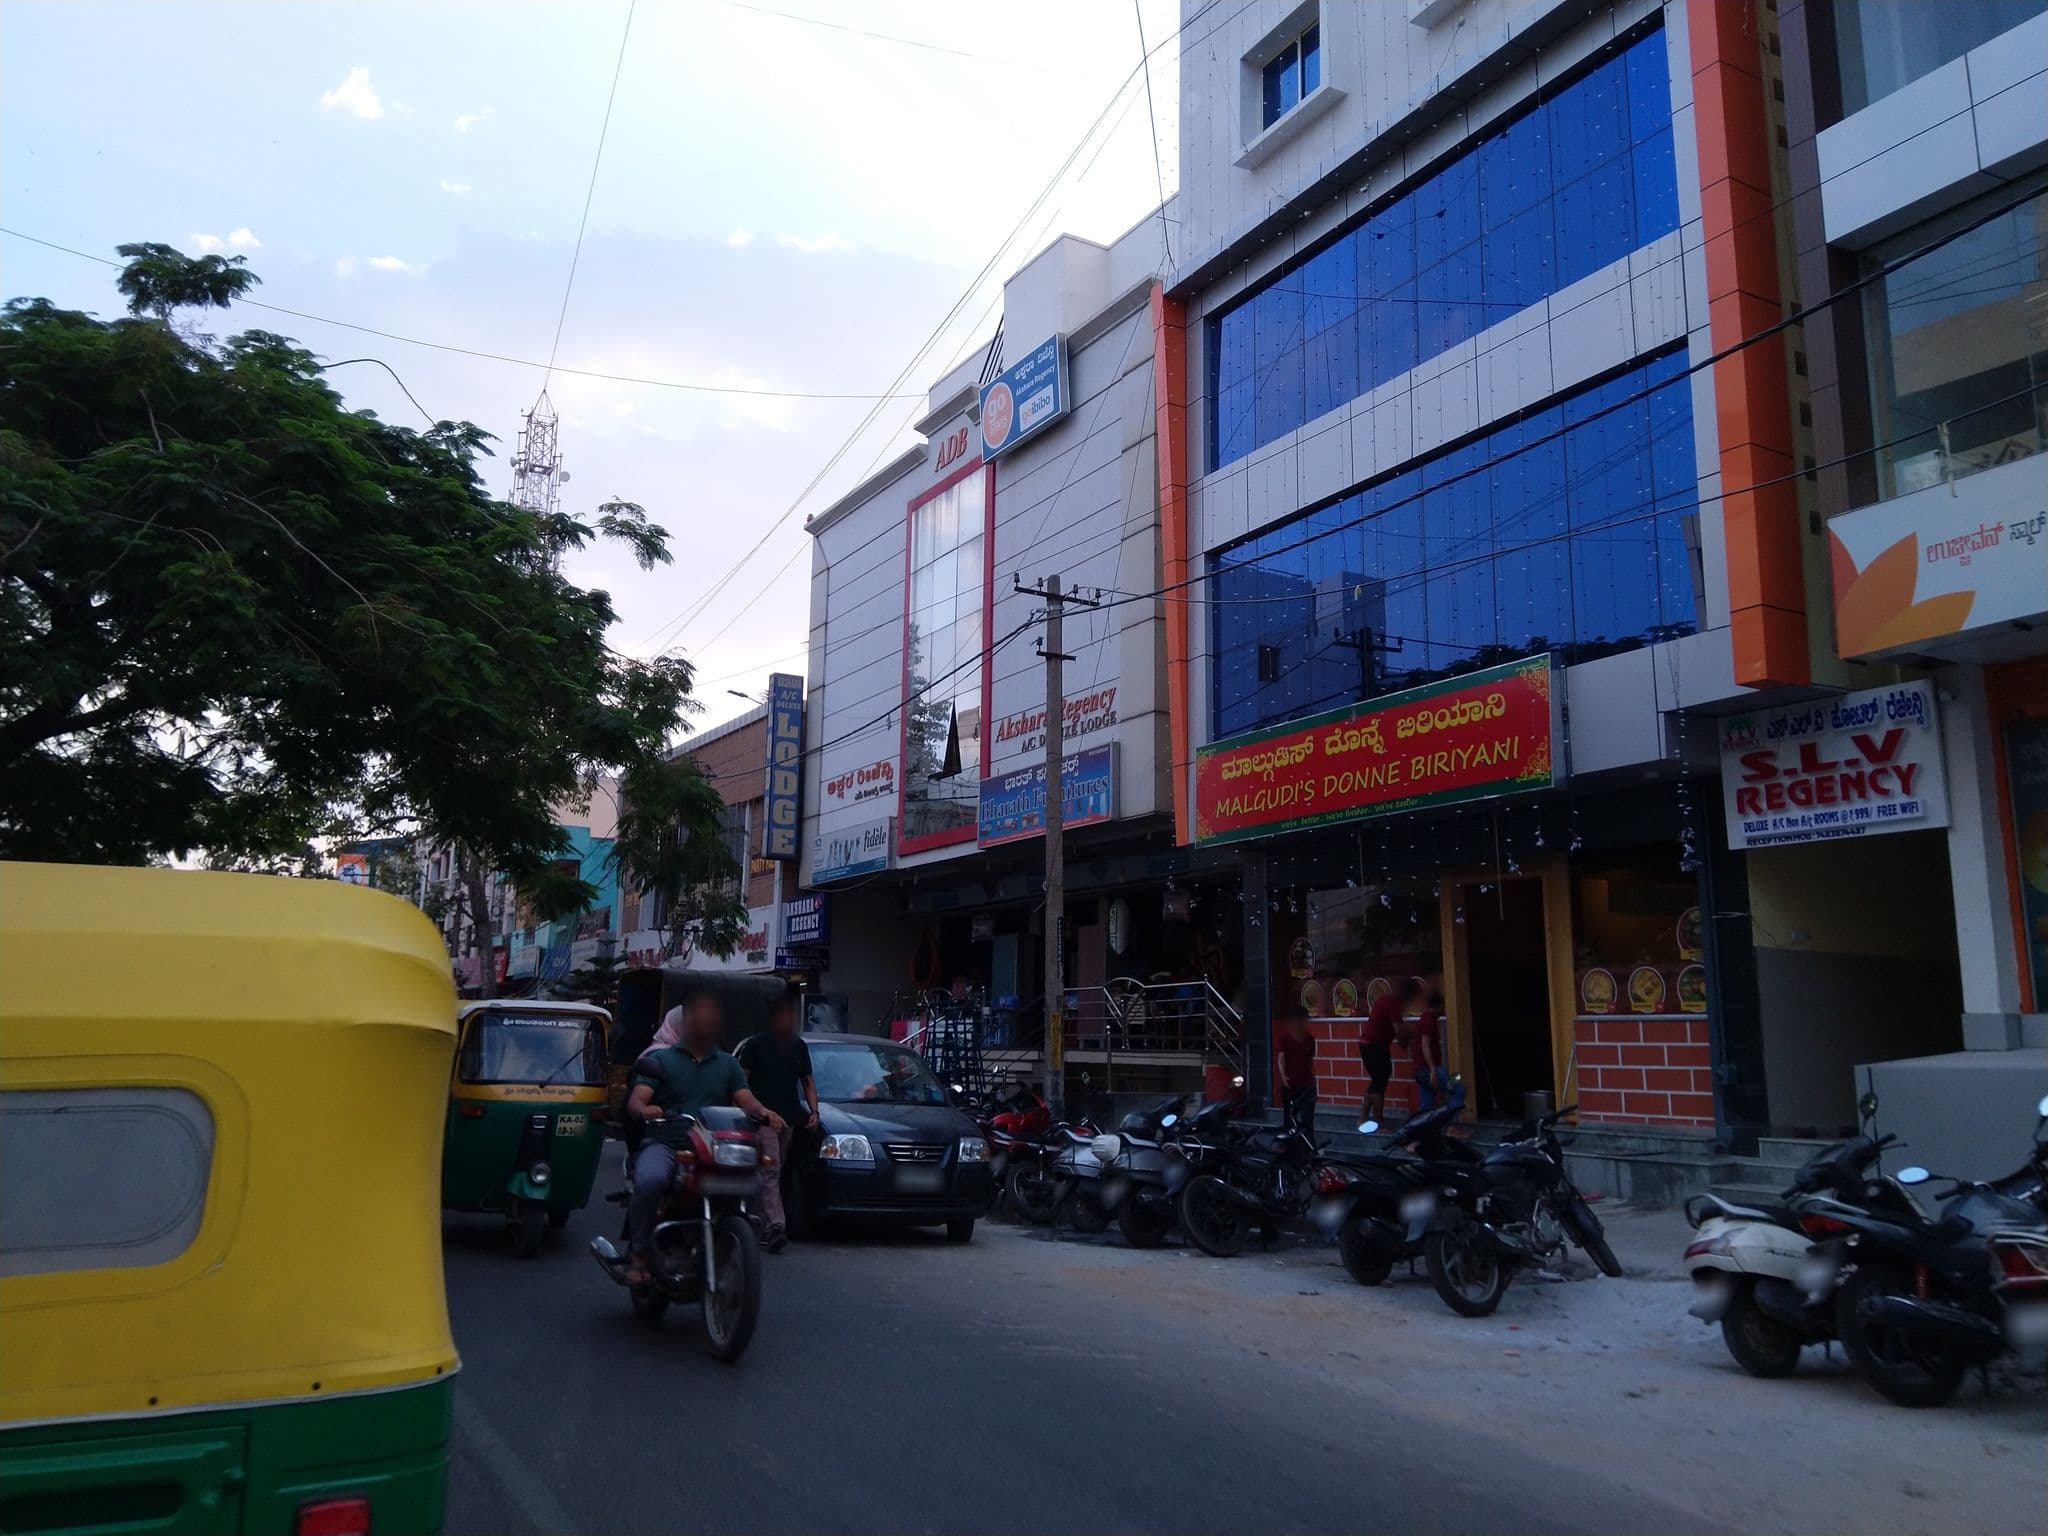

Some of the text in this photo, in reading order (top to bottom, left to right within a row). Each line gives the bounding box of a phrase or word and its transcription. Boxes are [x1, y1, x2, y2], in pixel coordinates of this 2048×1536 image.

[1034, 364, 1055, 385] Regency
[988, 393, 1006, 422] go
[1022, 394, 1051, 425] goibibo
[935, 427, 968, 472] ADB
[781, 690, 798, 700] A/C
[1021, 735, 1036, 752] A/C
[1080, 711, 1117, 735] LODGE
[1221, 735, 1314, 782] ಮಾಲ್ಗುಡಿಸ್
[1396, 692, 1506, 739] ಬಿರಿಯಾನಿ
[771, 712, 798, 855] LODGE
[1216, 736, 1520, 819] MALGUDI'S DONNE BIRIYANI
[1736, 763, 1917, 816] REGENCY
[980, 788, 1030, 823] Bharath
[1743, 819, 1769, 834] DELUXE
[1814, 811, 1839, 826] ROOMS
[1877, 803, 1898, 819] FREE
[1899, 800, 1920, 817] WIFI
[864, 826, 887, 852] fidèle
[791, 913, 819, 932] REGENCY
